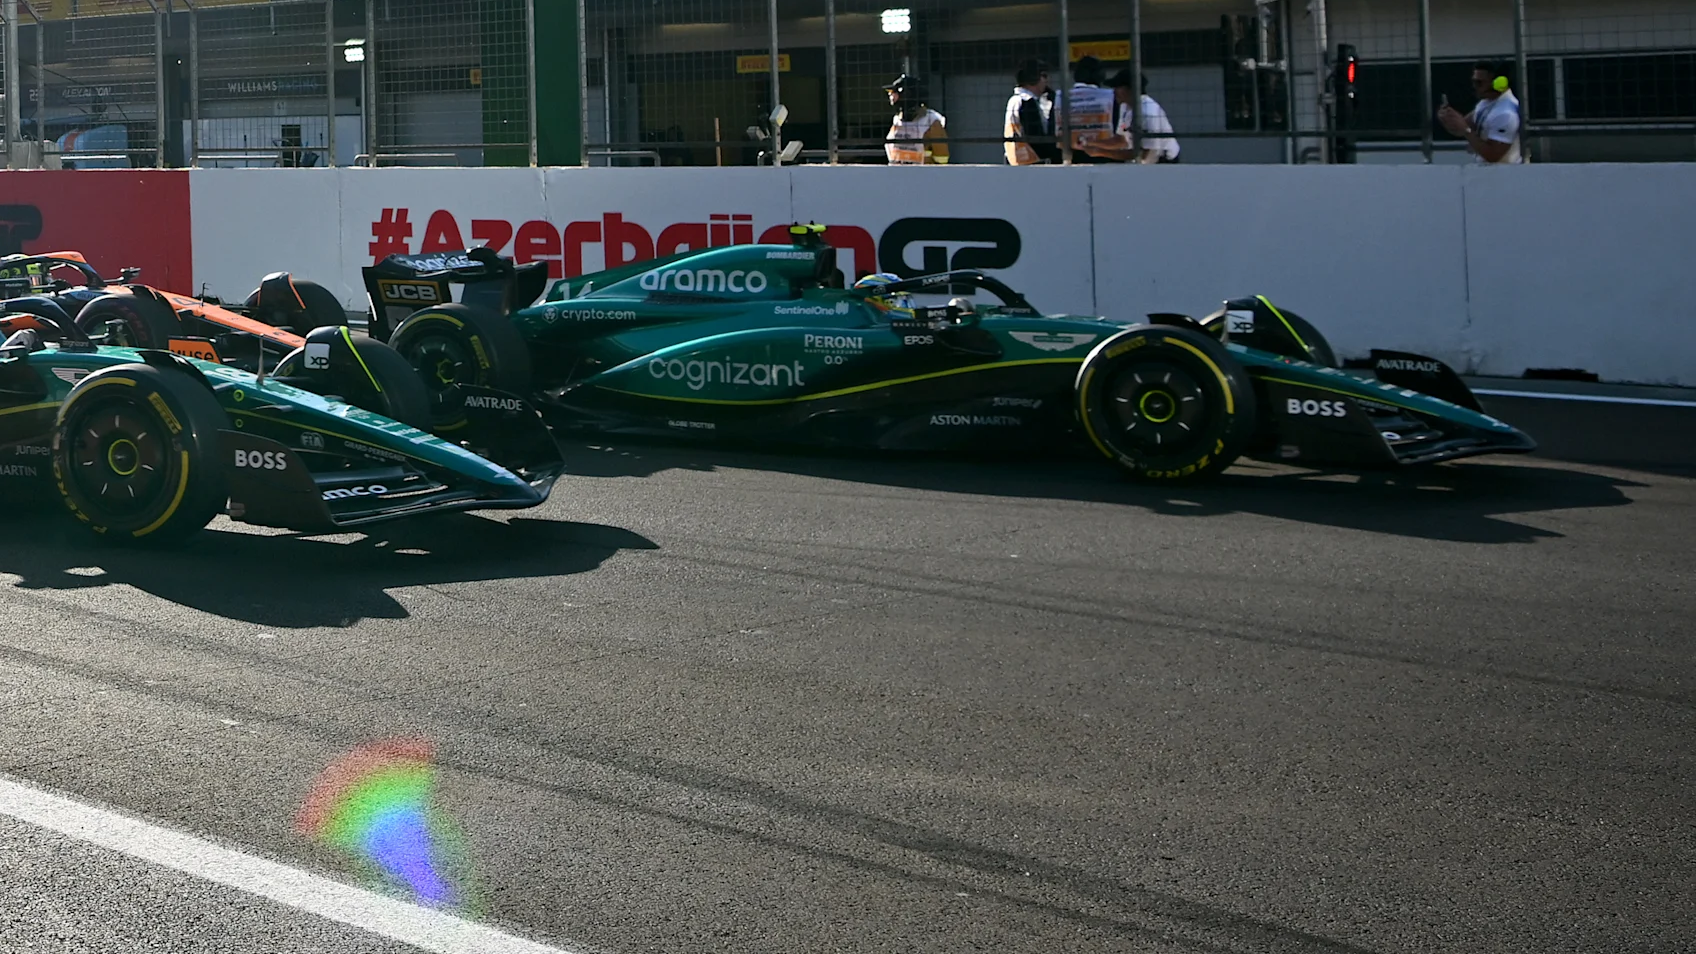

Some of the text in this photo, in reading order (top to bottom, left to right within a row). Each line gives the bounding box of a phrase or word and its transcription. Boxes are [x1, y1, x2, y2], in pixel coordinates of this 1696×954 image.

[227, 82, 278, 94] WILLIAMS
[766, 251, 815, 260] BOMBARDIER
[639, 269, 768, 293] aramco
[385, 283, 437, 301] JCB
[561, 308, 636, 322] crypto.com
[774, 305, 835, 316] SentinelOne
[804, 334, 863, 349] PERONI
[904, 335, 934, 345] EPOS
[170, 348, 215, 362] use
[1376, 358, 1442, 373] AVATRADE
[649, 356, 805, 391] cognizant
[464, 395, 523, 412] AVATRADE
[1287, 398, 1346, 418] BOSS
[929, 415, 1021, 426] ASTON MARTIN
[234, 449, 287, 470] BOSS
